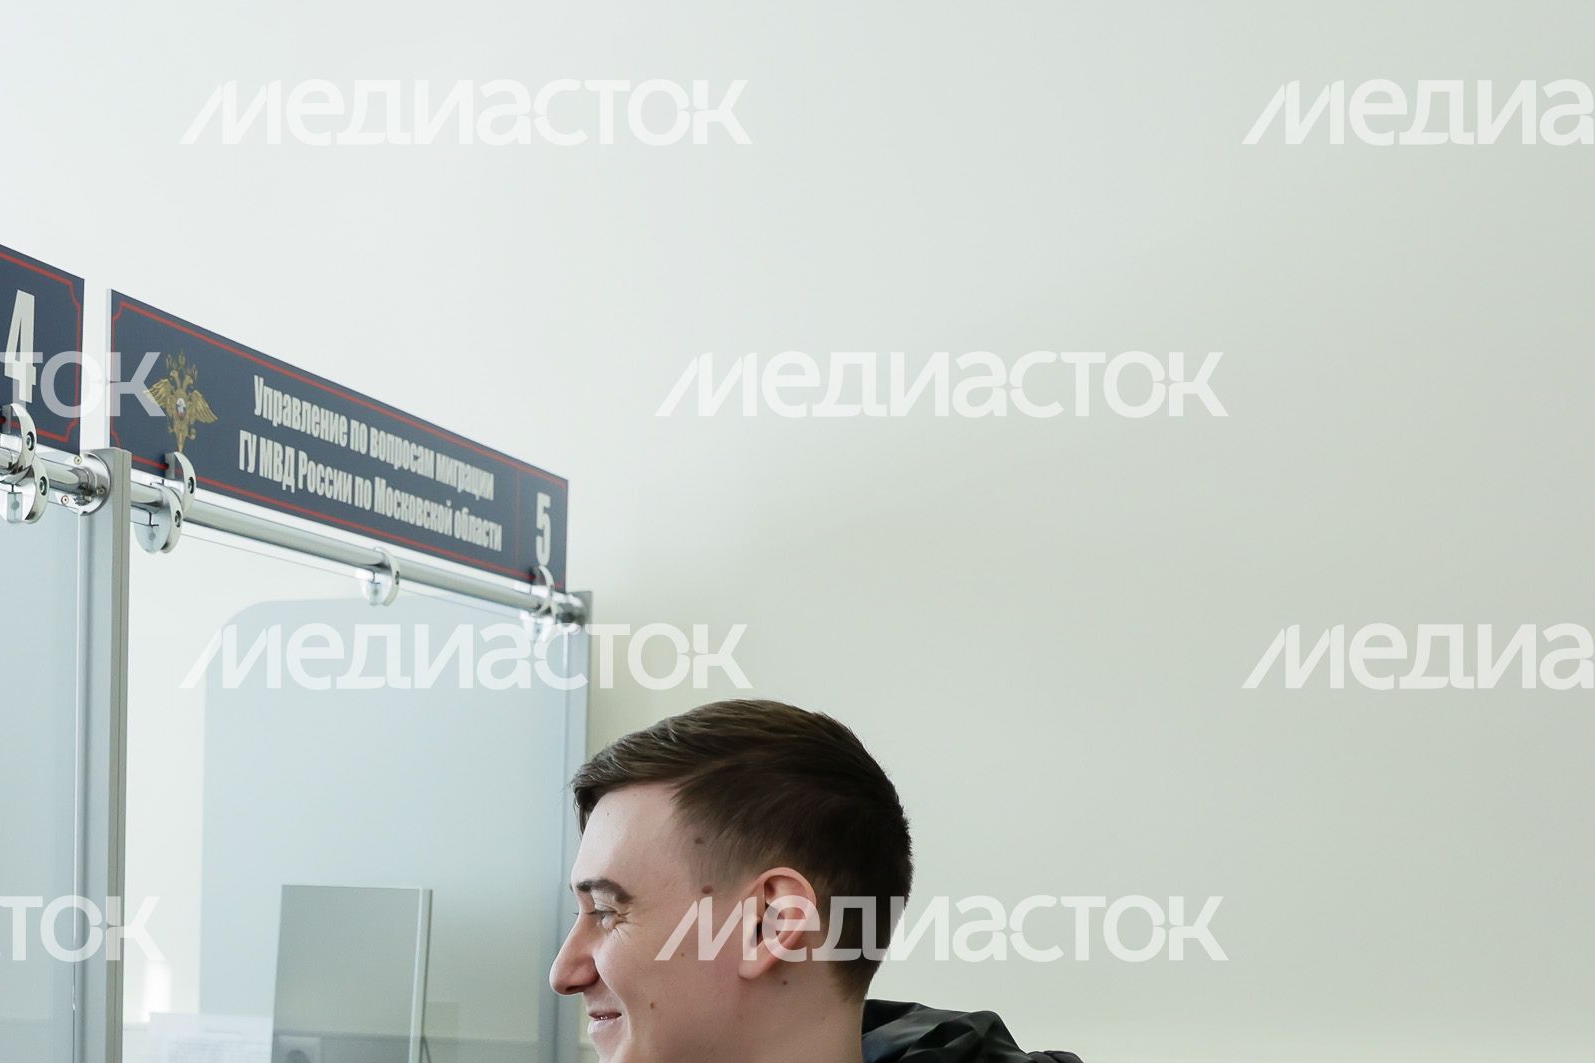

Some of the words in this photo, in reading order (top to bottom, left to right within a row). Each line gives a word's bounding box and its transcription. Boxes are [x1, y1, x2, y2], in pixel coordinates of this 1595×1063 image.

[3, 289, 37, 403] 4
[238, 429, 257, 474] ГУ
[259, 436, 296, 494] МВД
[297, 450, 353, 505] России
[354, 476, 372, 510] по
[374, 476, 453, 537] Московской
[454, 506, 503, 552] области
[254, 374, 348, 448] Управление
[349, 419, 368, 455] по
[369, 427, 434, 480] вопросам
[435, 452, 495, 501] миграции
[535, 491, 551, 567] 5
